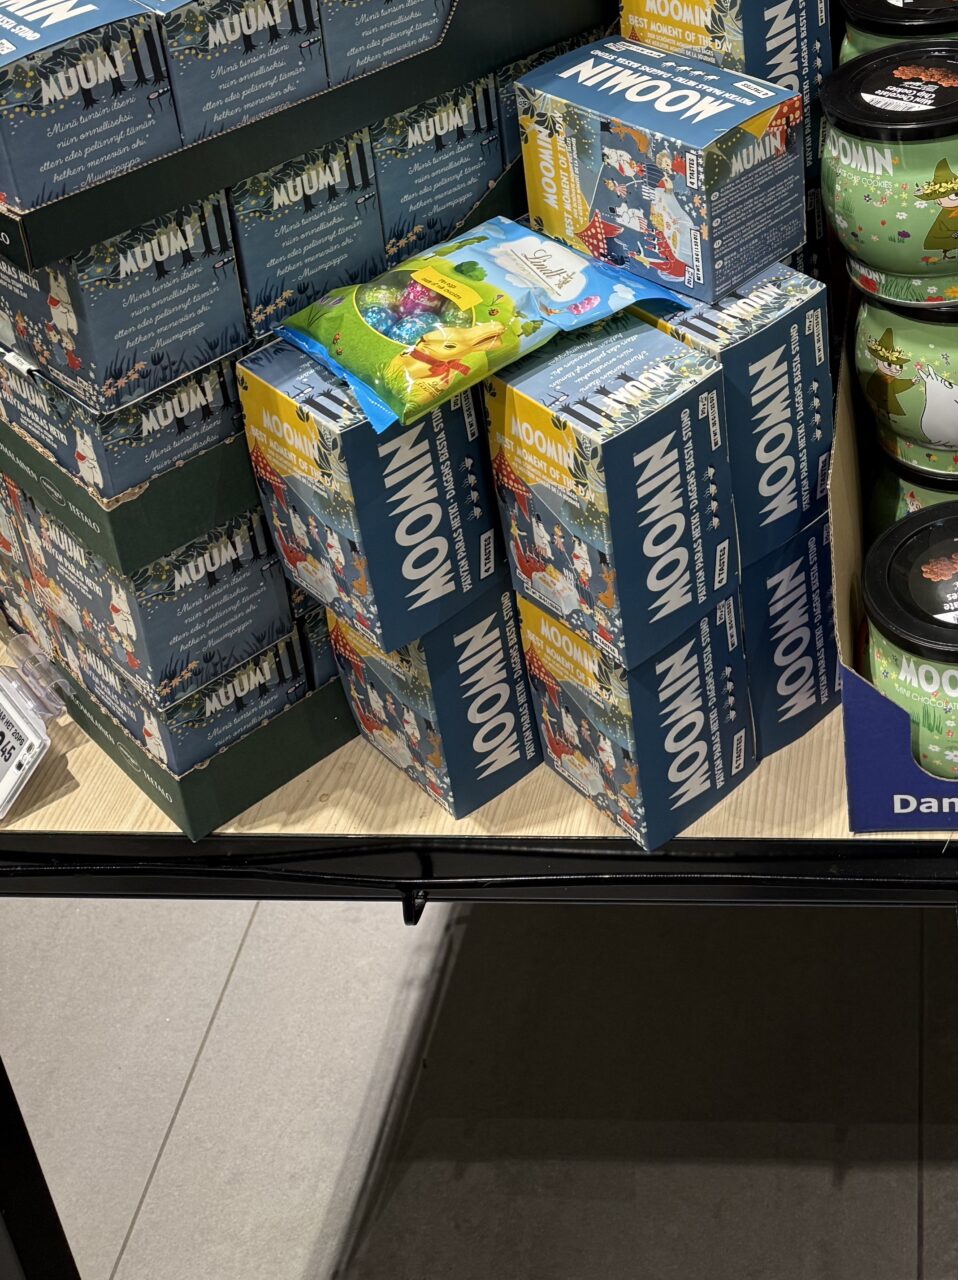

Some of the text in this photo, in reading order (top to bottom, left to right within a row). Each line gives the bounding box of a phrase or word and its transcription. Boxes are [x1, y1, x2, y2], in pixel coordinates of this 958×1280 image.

[206, 0, 283, 51] MUUMI
[628, 13, 649, 30] BEST
[649, 19, 683, 40] MOMENT
[684, 30, 696, 42] OF
[714, 39, 734, 54] DAY
[40, 49, 126, 106] MUUMI
[558, 56, 738, 126] MOOMIN
[405, 103, 470, 150] MUUMI
[729, 130, 782, 179] MUMIN
[271, 159, 342, 213] MUUMI
[119, 223, 195, 279] MUUMI
[526, 246, 570, 281] Lindt
[140, 379, 214, 438] MUUMI
[748, 343, 799, 528] MOOMIN
[510, 415, 576, 473] MOOMIN
[377, 421, 457, 612] MOOMIN
[686, 469, 699, 510] DAGENS
[632, 429, 693, 625] MOOMIN
[173, 534, 246, 594] MUUMI
[717, 546, 727, 578] TASTES
[765, 556, 817, 723] MOOMIN
[204, 661, 273, 718] MUUMI
[453, 610, 521, 782] MOOMIN
[654, 637, 712, 812] MOOMIN
